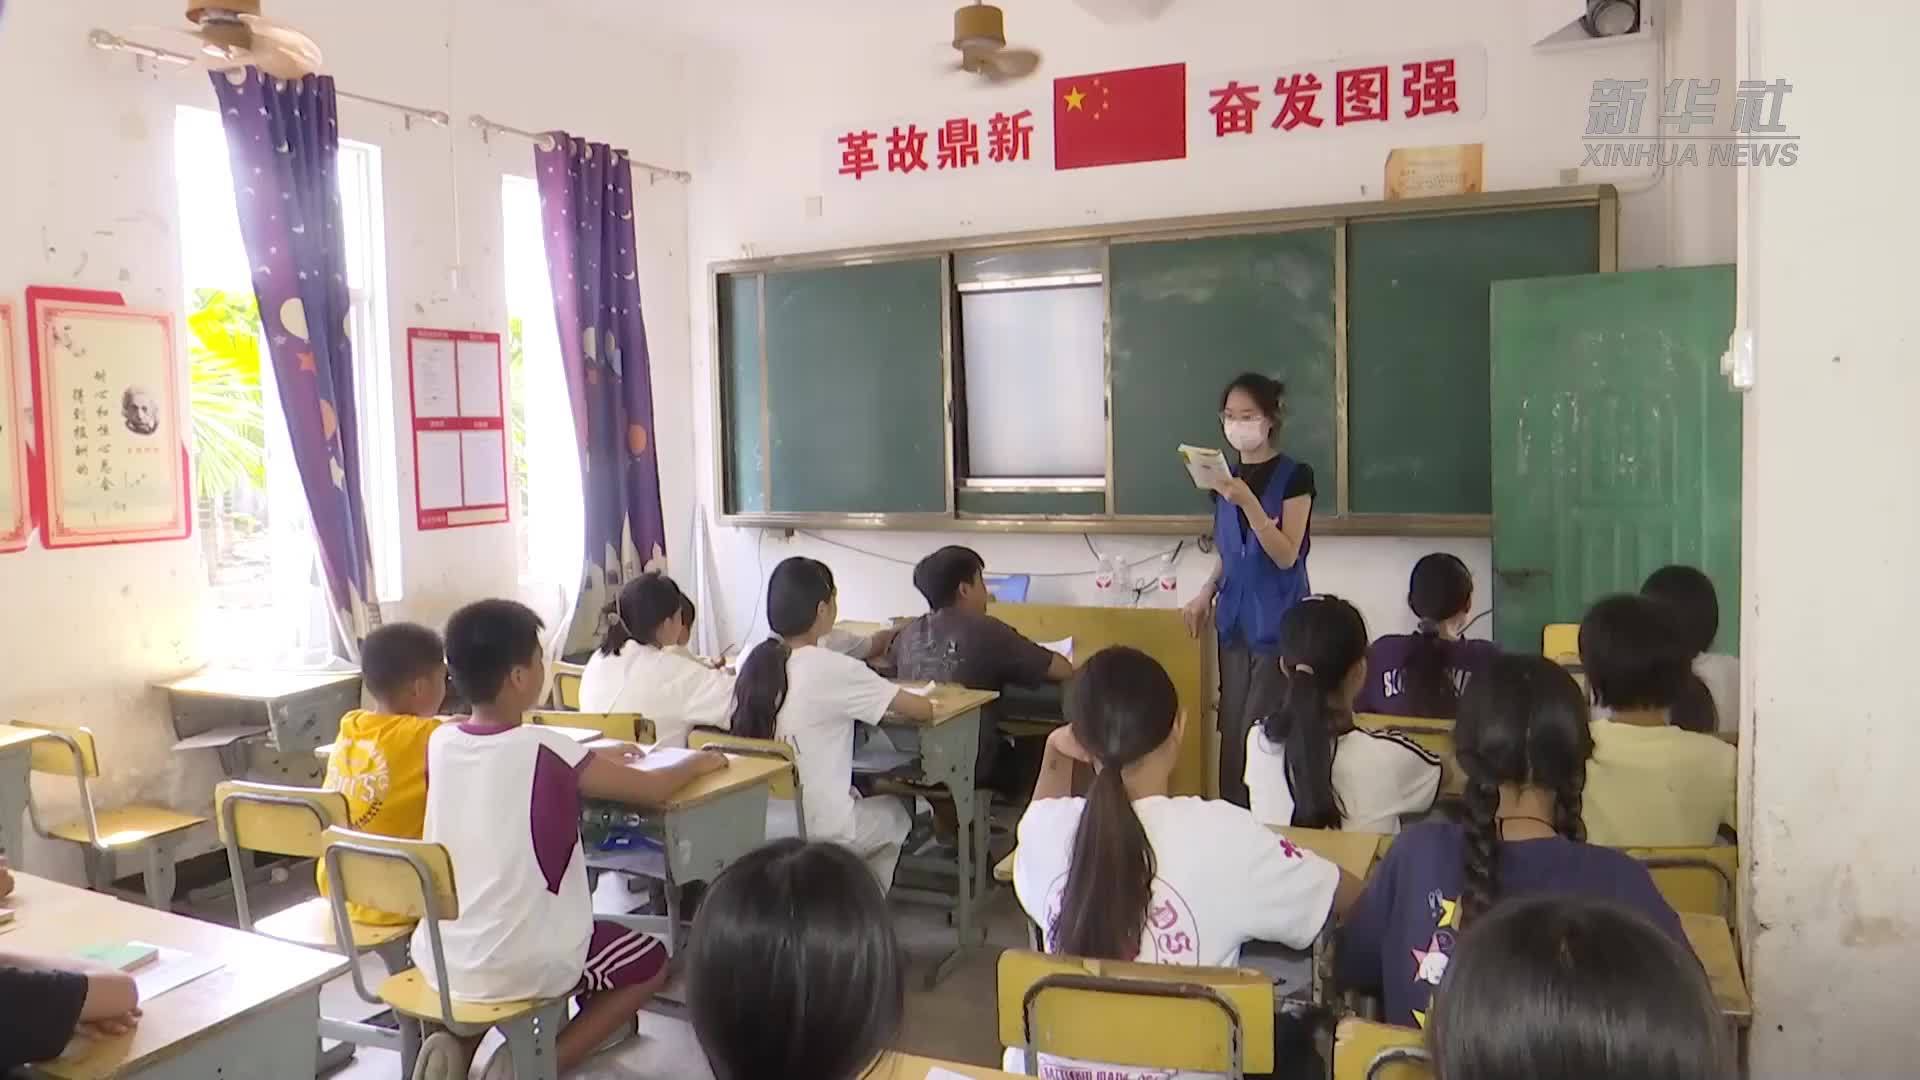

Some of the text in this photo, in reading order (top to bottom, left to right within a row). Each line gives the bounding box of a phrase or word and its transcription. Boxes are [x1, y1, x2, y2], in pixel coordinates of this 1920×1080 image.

[1208, 57, 1460, 138] 奋发图强
[837, 108, 1036, 181] 革故鼎新
